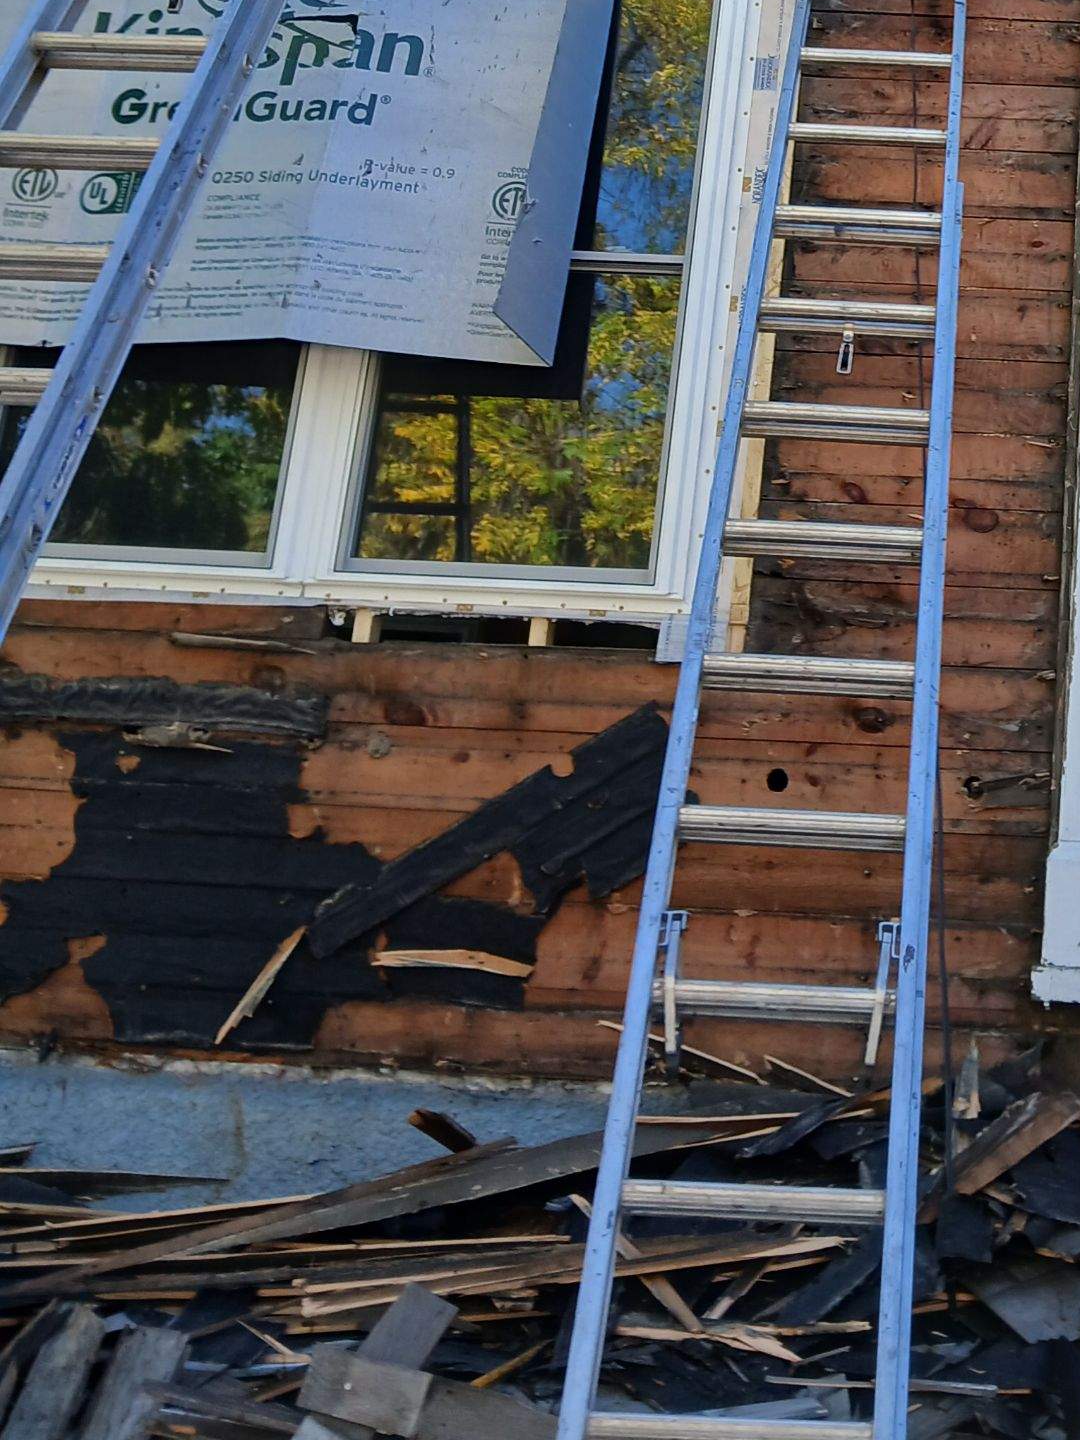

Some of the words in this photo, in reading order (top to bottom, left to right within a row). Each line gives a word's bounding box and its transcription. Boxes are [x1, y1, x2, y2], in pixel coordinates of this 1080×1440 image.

[258, 169, 304, 185] Siding
[308, 168, 420, 194] Underlayment
[432, 166, 456, 179] 0.9
